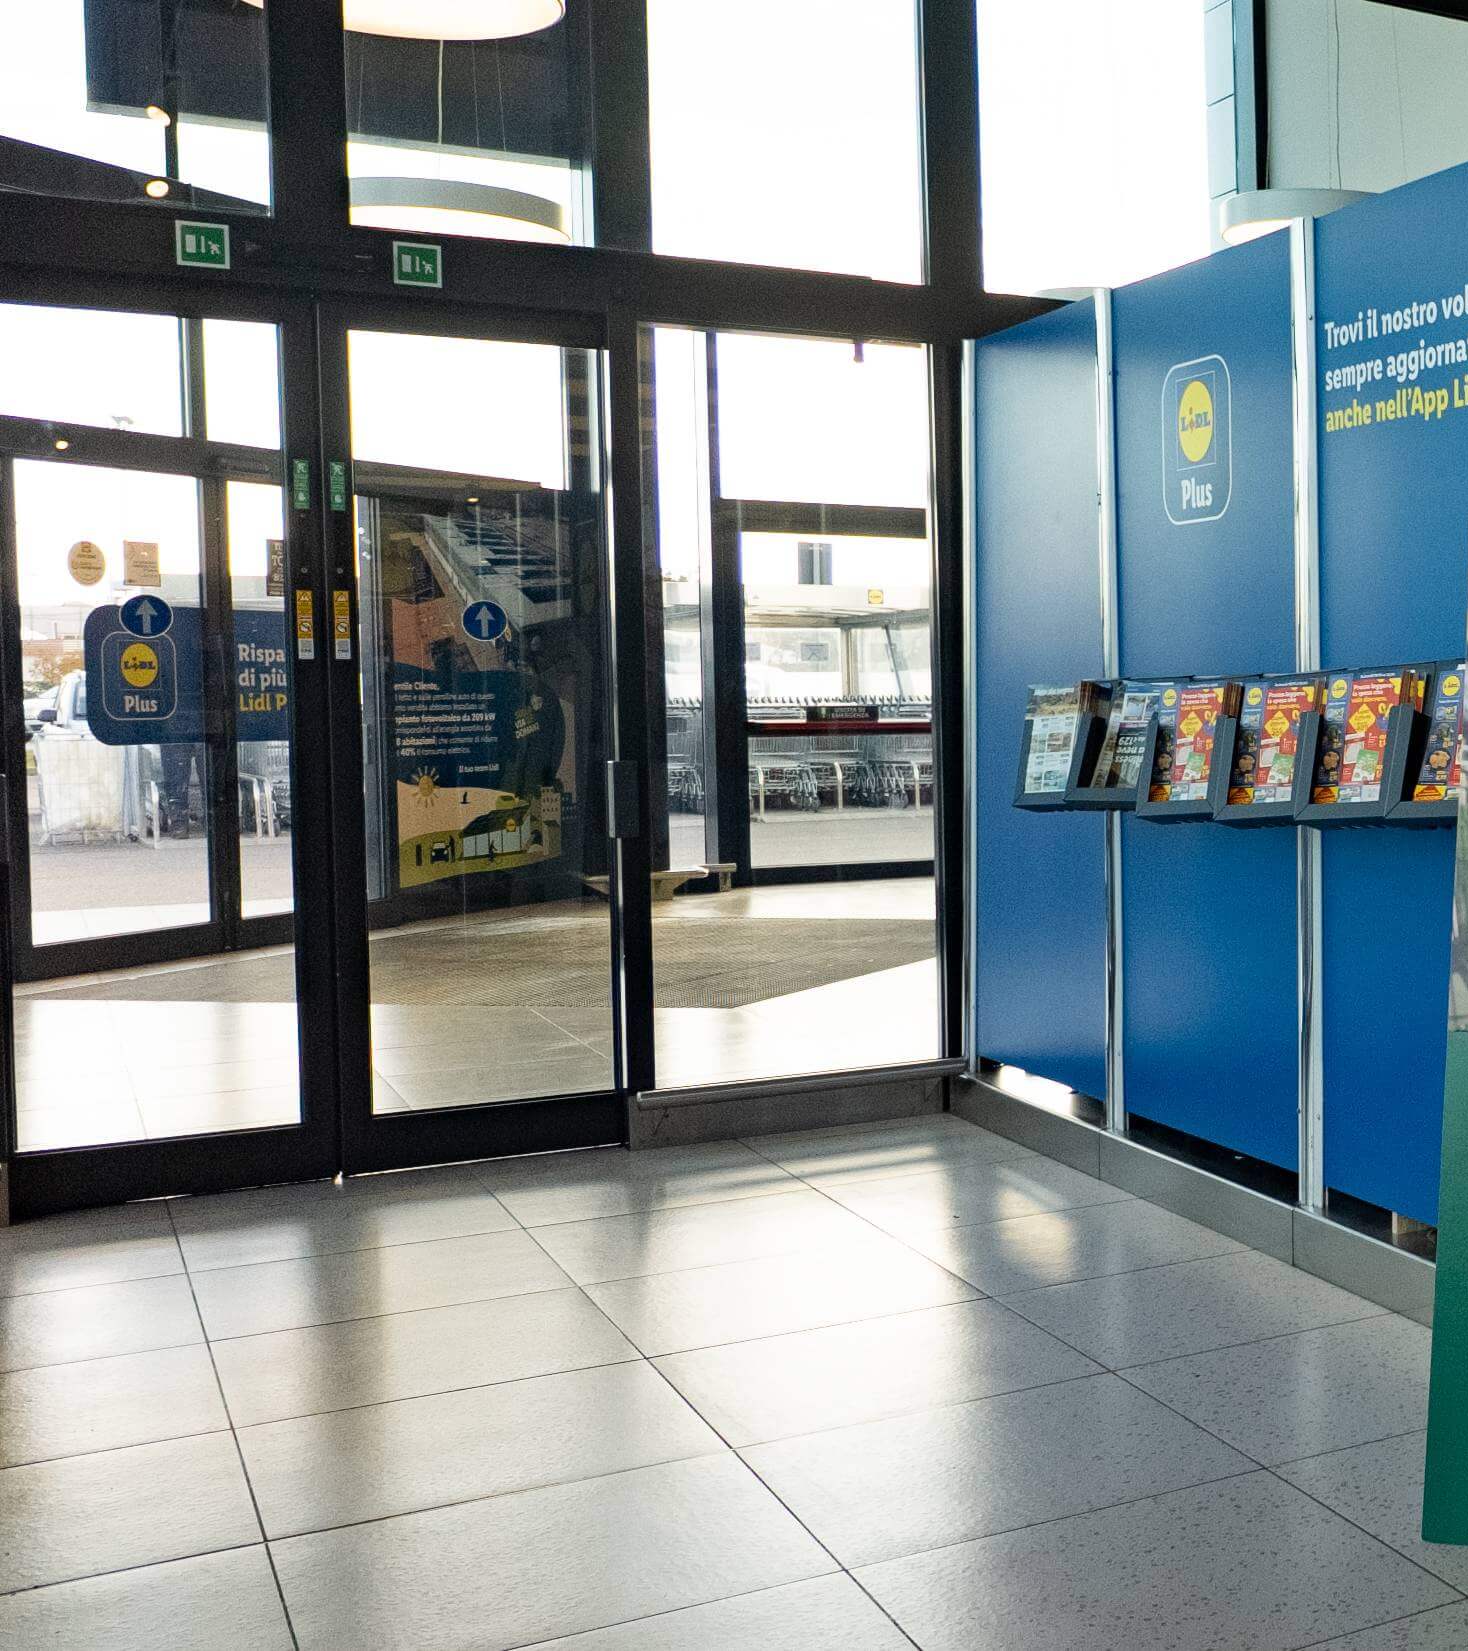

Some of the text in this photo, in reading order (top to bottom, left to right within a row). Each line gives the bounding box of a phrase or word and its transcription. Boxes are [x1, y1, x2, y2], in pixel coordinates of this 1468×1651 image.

[1325, 313, 1363, 350] Trovi
[1367, 308, 1379, 340] il
[1381, 301, 1438, 337] nostro
[1325, 361, 1383, 393] sempre
[1180, 406, 1211, 433] LIDL
[1326, 396, 1371, 433] anche
[1181, 478, 1213, 509] Plus
[239, 670, 286, 691] di più
[124, 695, 158, 713] Plus
[240, 694, 271, 713] Lidl
